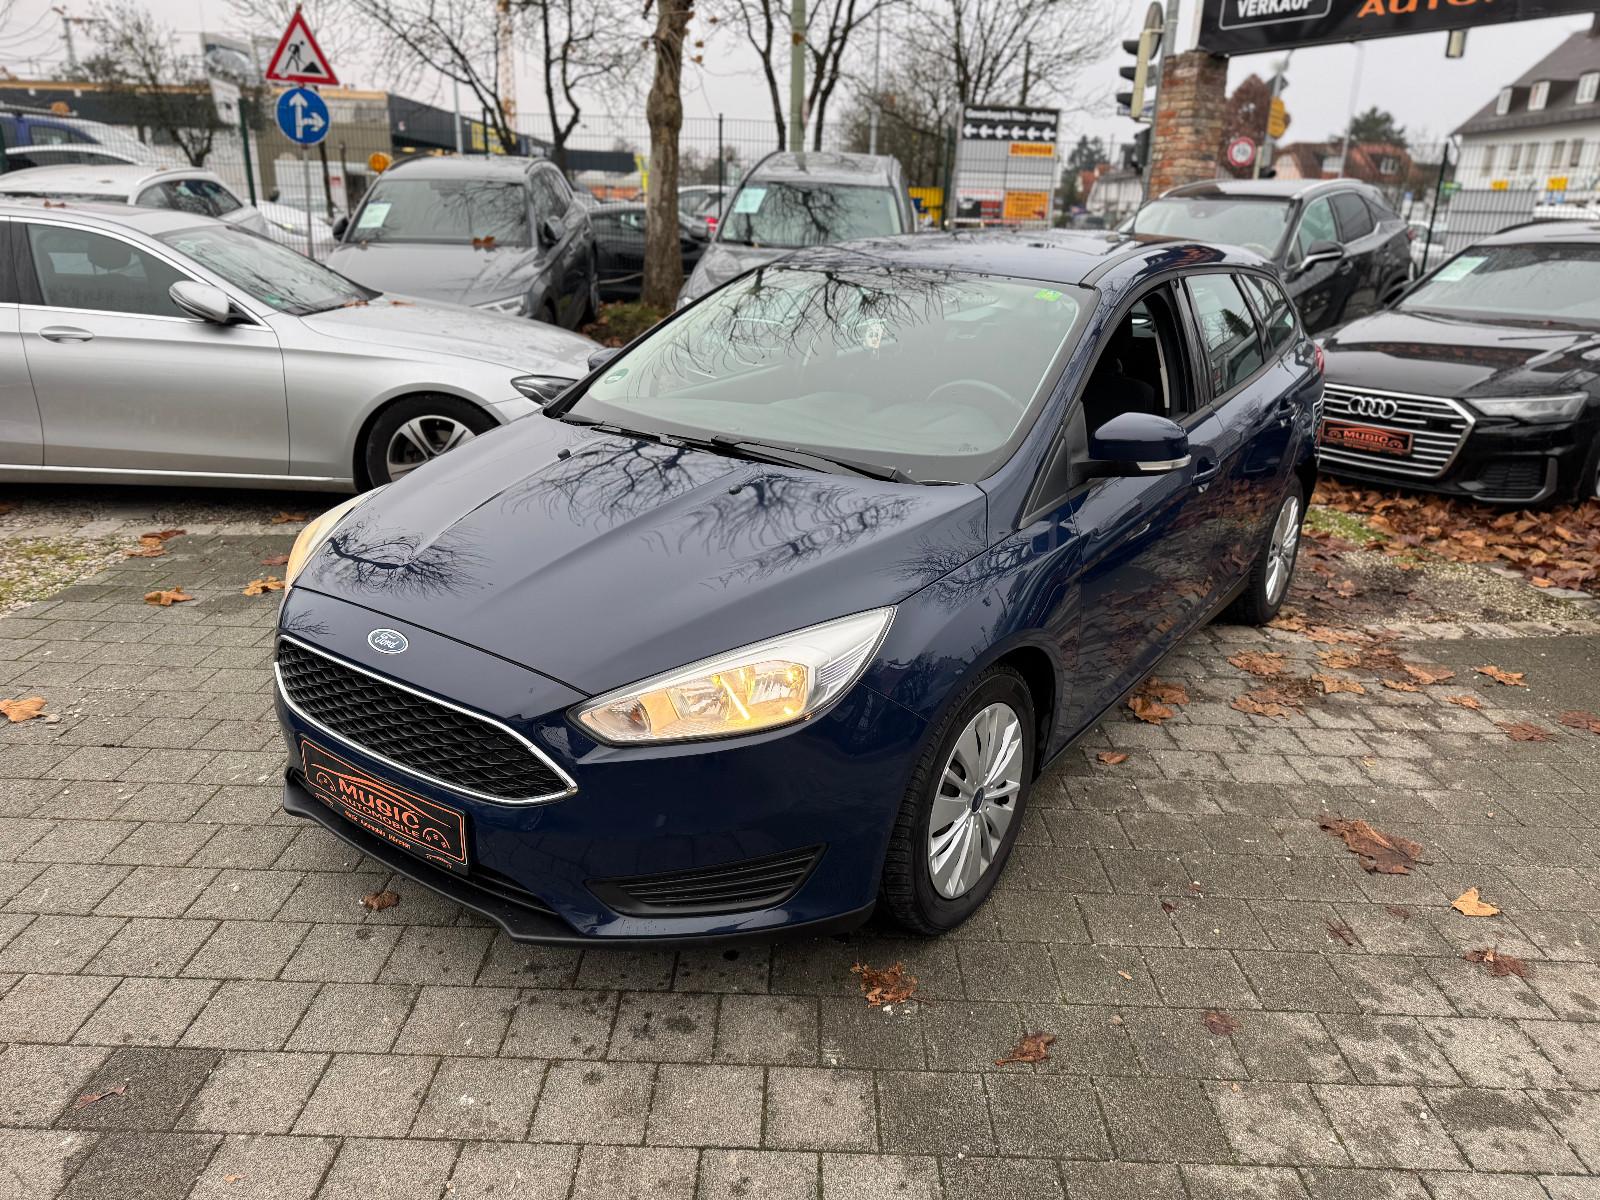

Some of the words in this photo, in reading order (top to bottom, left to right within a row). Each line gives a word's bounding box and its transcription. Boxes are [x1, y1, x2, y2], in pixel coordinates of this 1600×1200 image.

[1343, 431, 1389, 444] MUSIC
[375, 632, 400, 649] Ford
[338, 778, 420, 830] MUSIC
[340, 794, 420, 838] AUTOMOBILE
